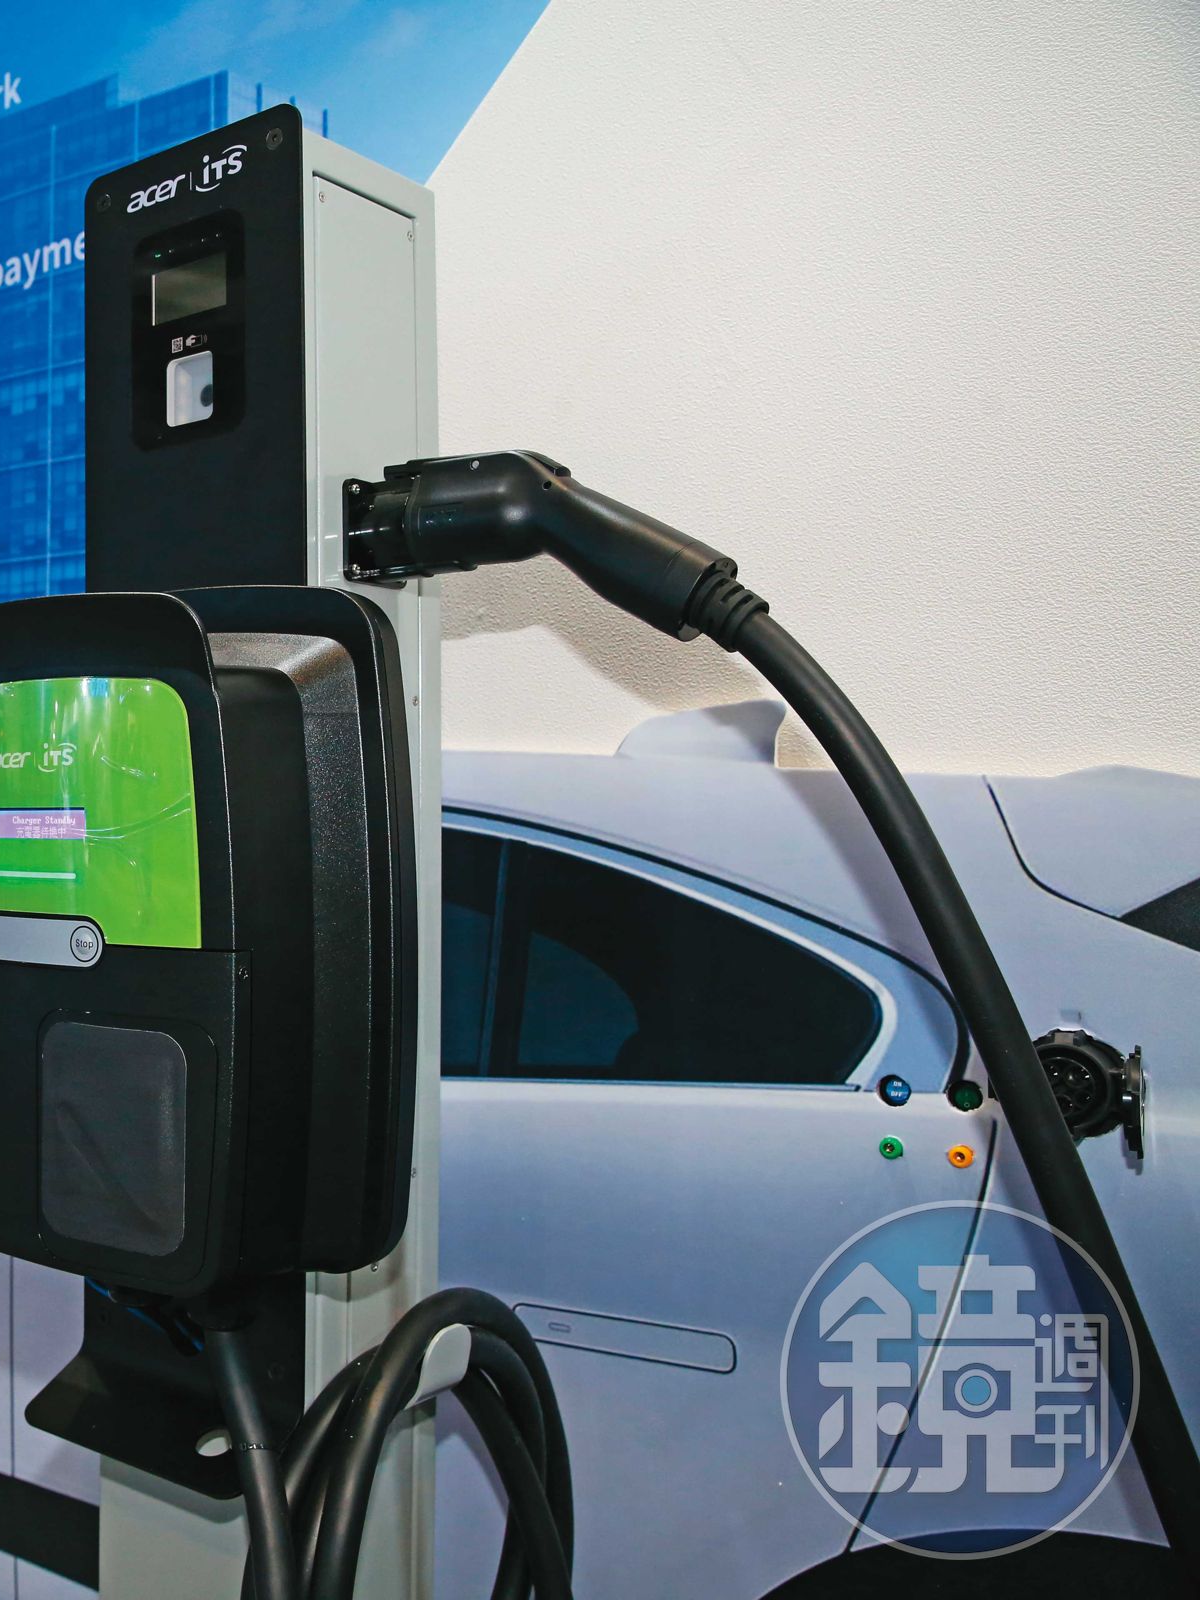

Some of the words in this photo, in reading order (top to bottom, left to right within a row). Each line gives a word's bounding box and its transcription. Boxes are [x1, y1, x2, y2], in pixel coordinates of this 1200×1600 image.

[126, 174, 186, 213] acer
[12, 815, 42, 826] Charger
[44, 815, 76, 826] Standby
[75, 938, 94, 949] Stop
